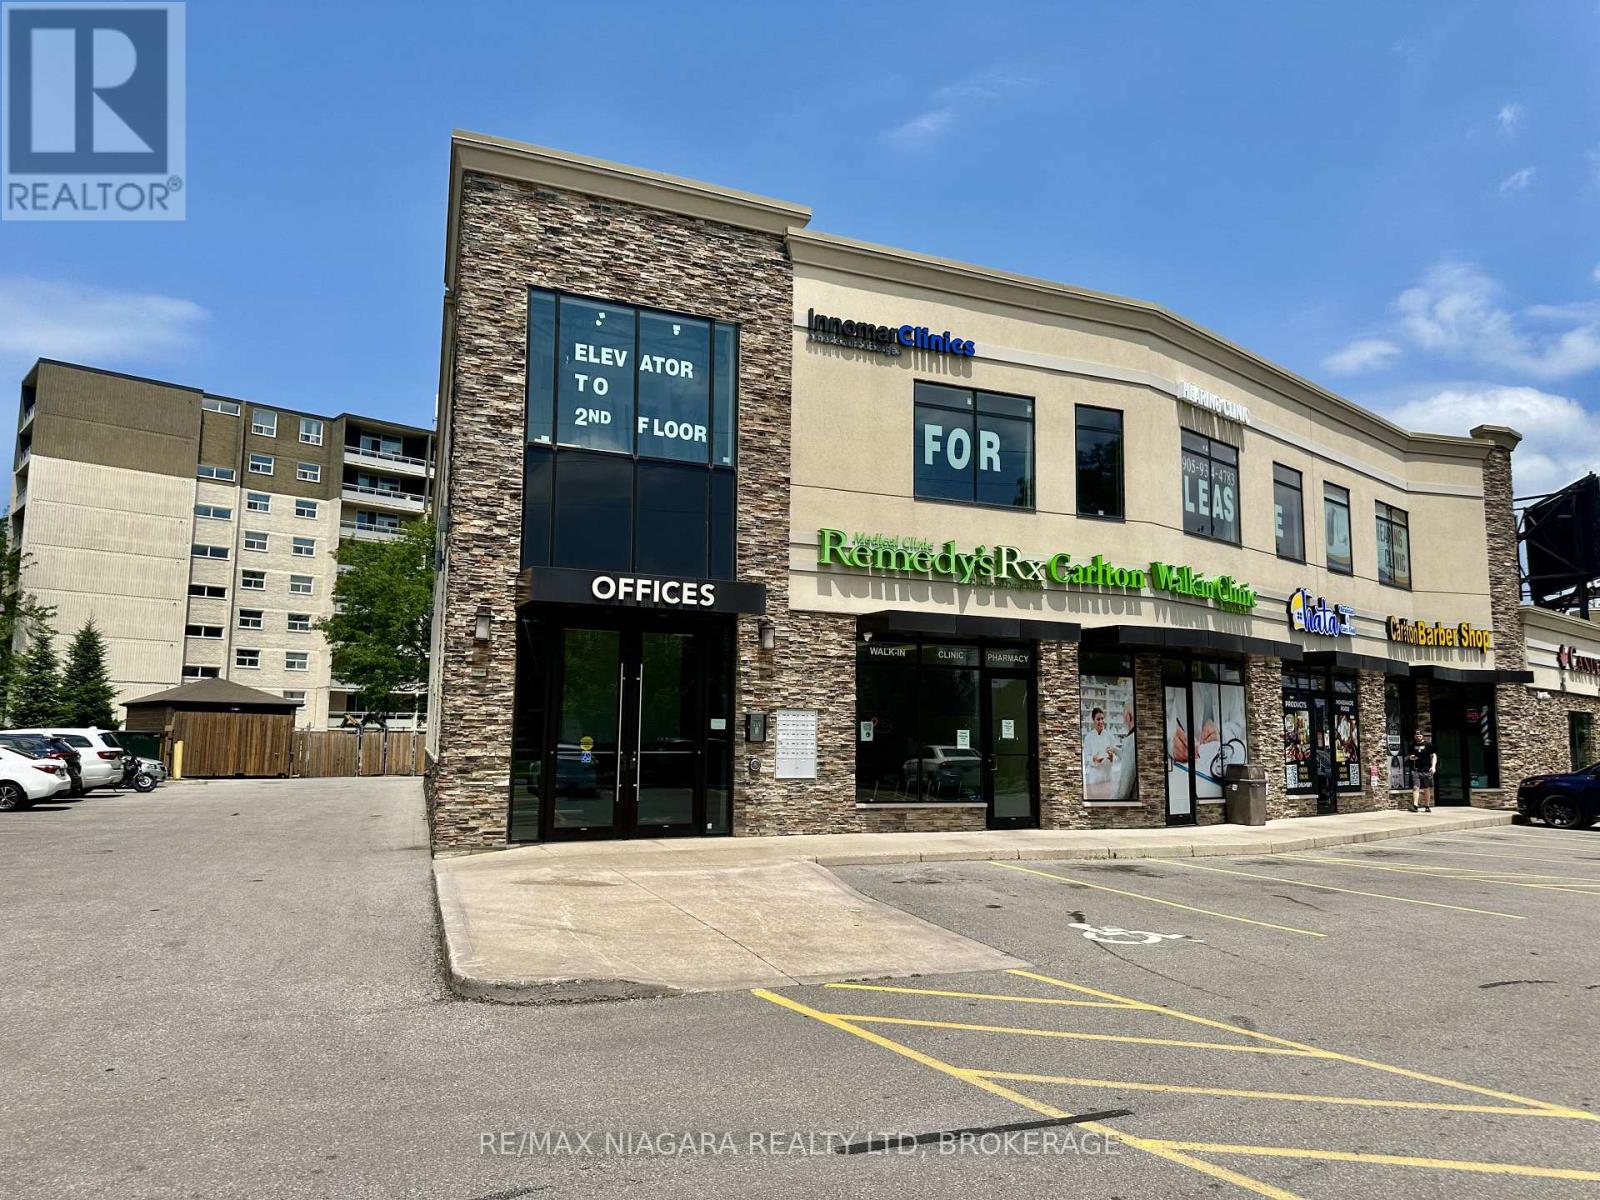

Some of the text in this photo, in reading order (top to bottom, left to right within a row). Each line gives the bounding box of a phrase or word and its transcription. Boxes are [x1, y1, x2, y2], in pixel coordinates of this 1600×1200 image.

[574, 374, 609, 396] TO
[574, 407, 612, 426] 2ND
[924, 423, 1002, 473] FOR
[1046, 553, 1146, 589] Carlton
[591, 575, 716, 607] OFFICES
[1459, 622, 1490, 654] Shop
[869, 647, 906, 658] WALK-IN
[938, 651, 964, 660] CLINIC
[987, 653, 1029, 663] PHARMACY
